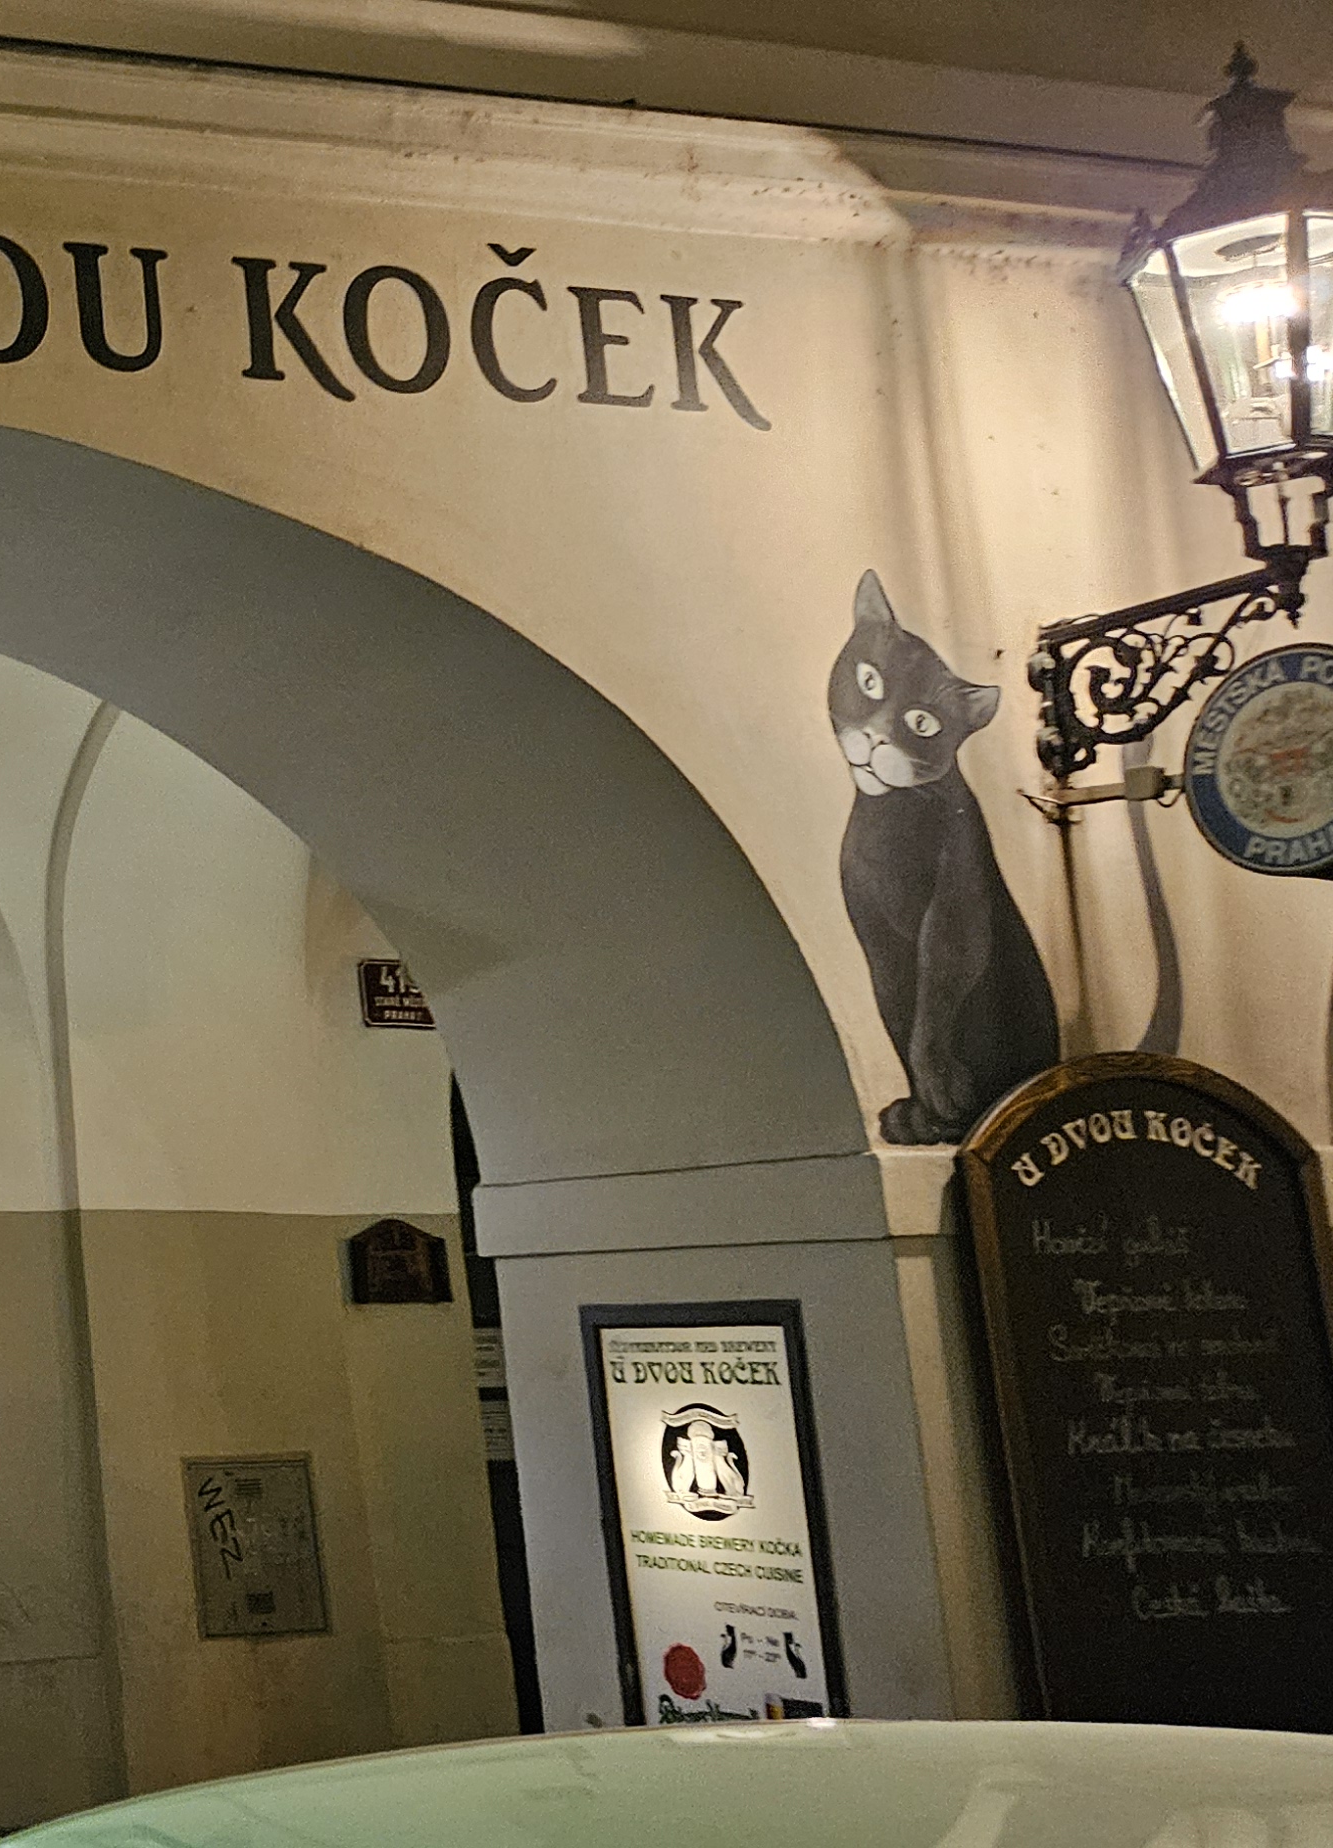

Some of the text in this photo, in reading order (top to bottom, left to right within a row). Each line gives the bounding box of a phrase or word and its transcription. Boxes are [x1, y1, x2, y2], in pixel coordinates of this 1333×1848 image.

[231, 243, 771, 432] KOČEK
[1243, 824, 1333, 866] PRAH
[380, 966, 421, 994] 41
[1011, 1109, 1263, 1190] U DVOU KOČEK
[631, 1361, 696, 1386] DVOU
[699, 1356, 783, 1387] KOČEK
[630, 1529, 804, 1558] HOMEMADE BREWERY KOČKA
[635, 1553, 804, 1585] TRADITIONAL CZECH CUISINE
